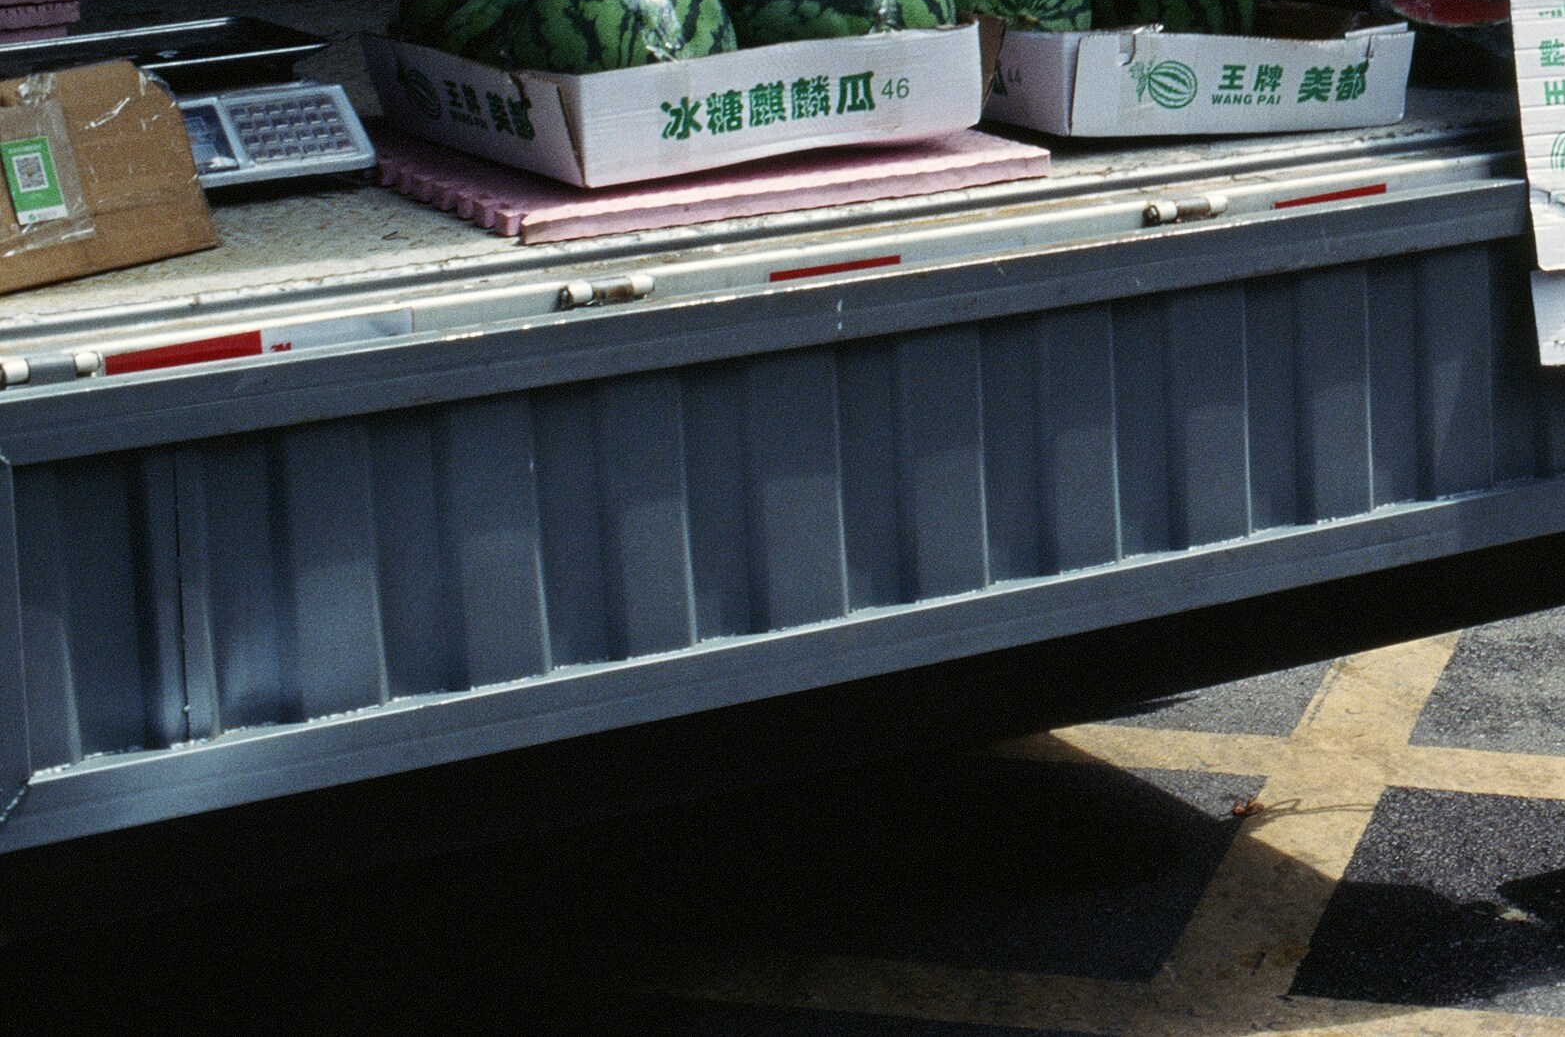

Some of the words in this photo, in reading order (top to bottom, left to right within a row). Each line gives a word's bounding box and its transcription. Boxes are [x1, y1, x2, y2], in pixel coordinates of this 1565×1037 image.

[660, 71, 876, 140] 冰糖麒麟瓜
[881, 77, 910, 100] 46
[1211, 92, 1252, 106] WANG
[1256, 92, 1281, 105] PAI
[1217, 63, 1283, 92] 王牌
[1297, 65, 1369, 103] 美都
[444, 79, 481, 114] 王牌
[485, 90, 536, 141] 美都
